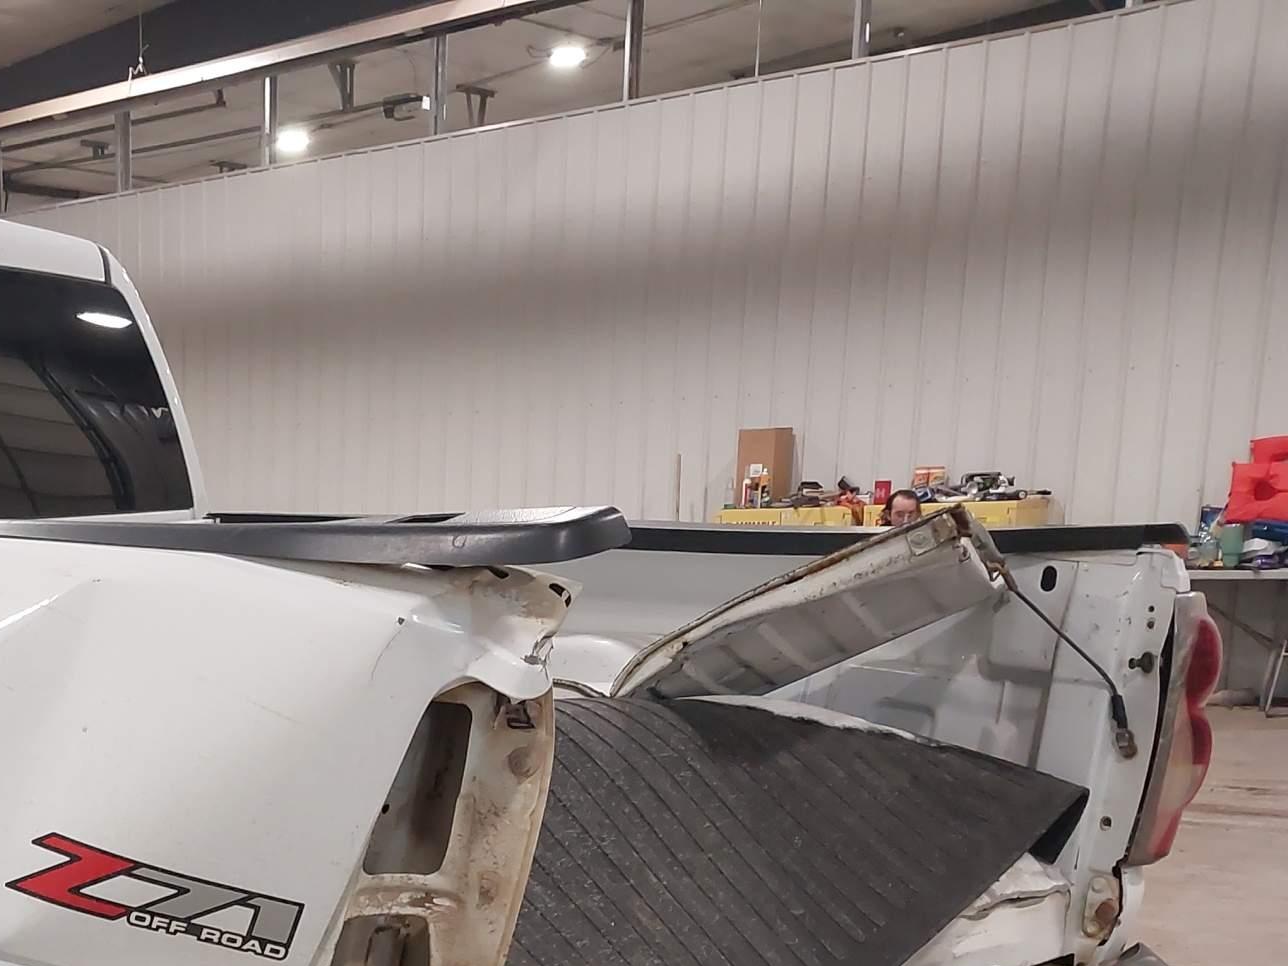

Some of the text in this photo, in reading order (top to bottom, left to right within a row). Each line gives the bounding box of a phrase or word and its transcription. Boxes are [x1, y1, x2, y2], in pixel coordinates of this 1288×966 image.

[4, 831, 305, 946] Z71
[128, 910, 289, 961] OFF ROAD
